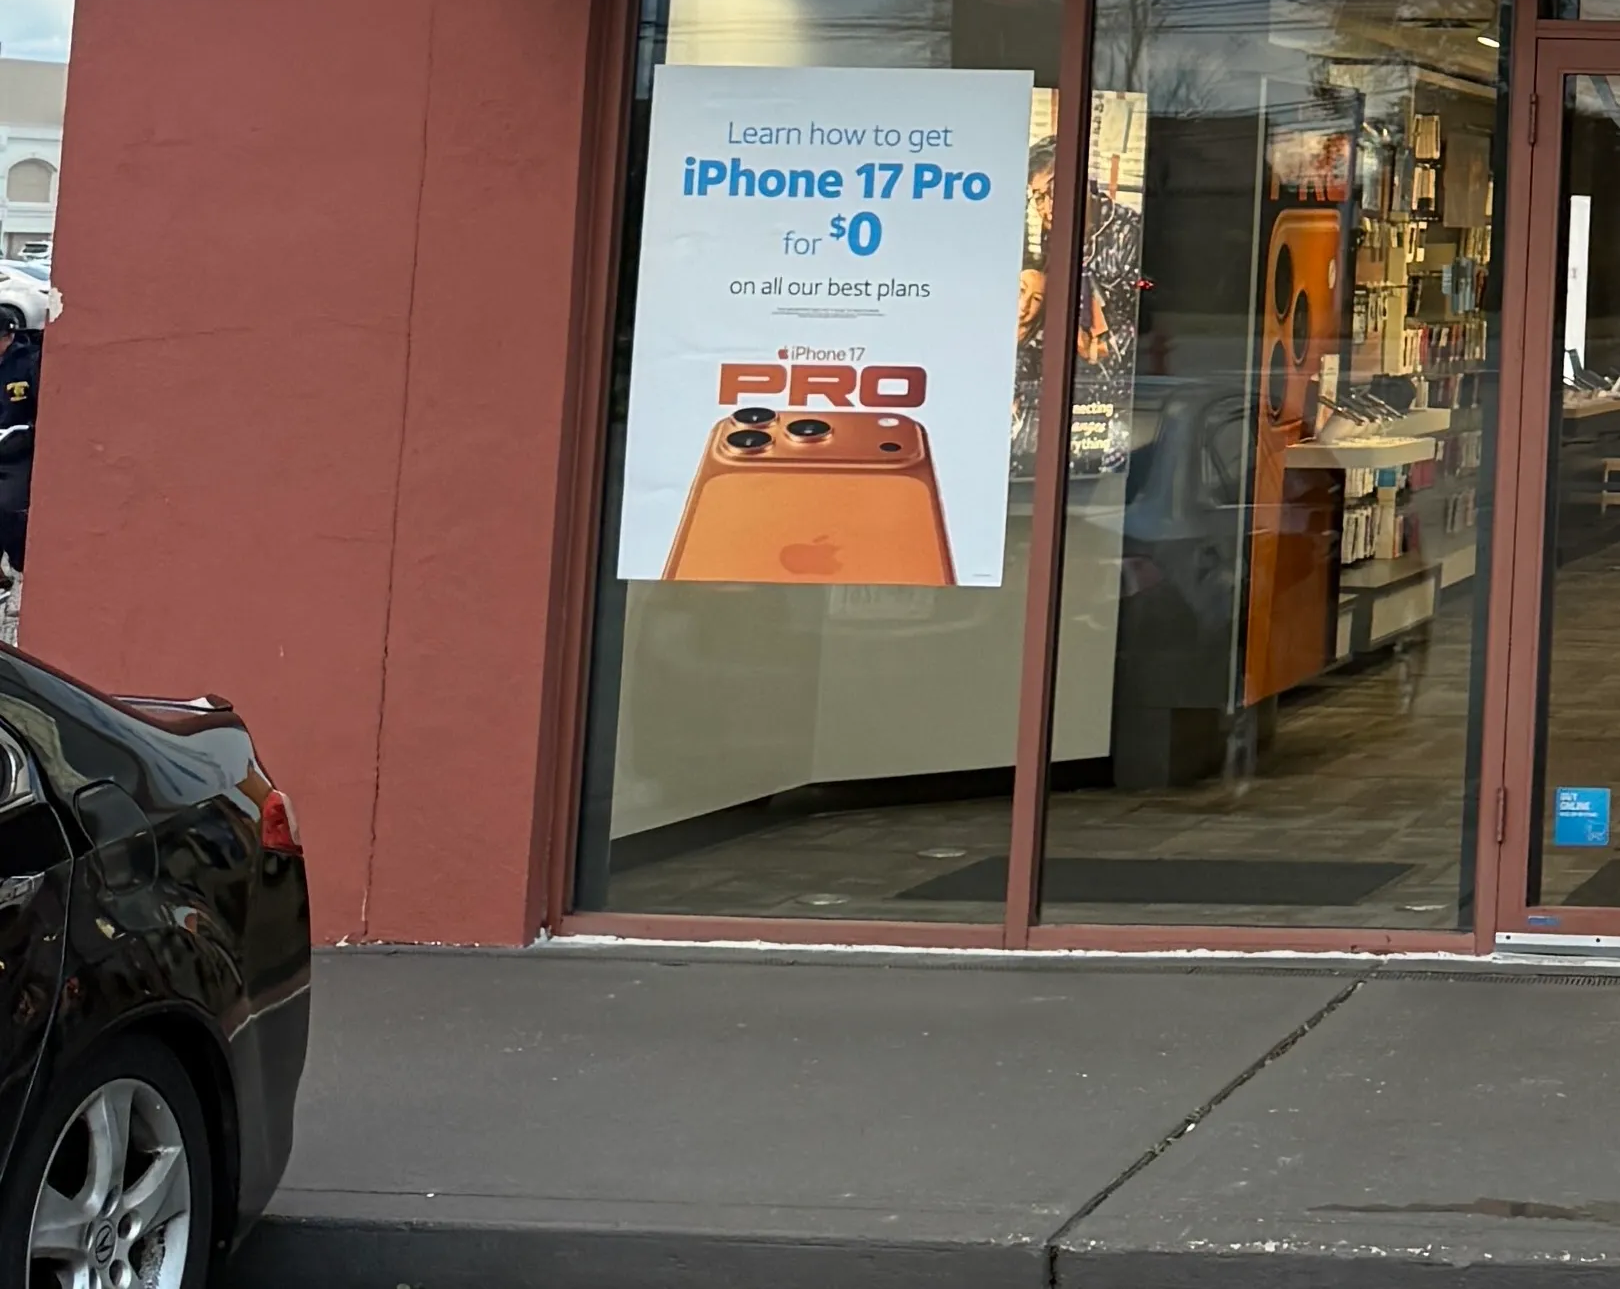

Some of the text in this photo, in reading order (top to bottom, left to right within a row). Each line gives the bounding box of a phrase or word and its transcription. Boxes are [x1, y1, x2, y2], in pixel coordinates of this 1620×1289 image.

[728, 121, 953, 154] Learn how to get
[683, 156, 991, 201] iPhone 17 Pro
[783, 211, 882, 257] for $0
[729, 276, 931, 302] on all our best plans
[791, 345, 866, 362] iPhone 17
[718, 363, 928, 408] PRO
